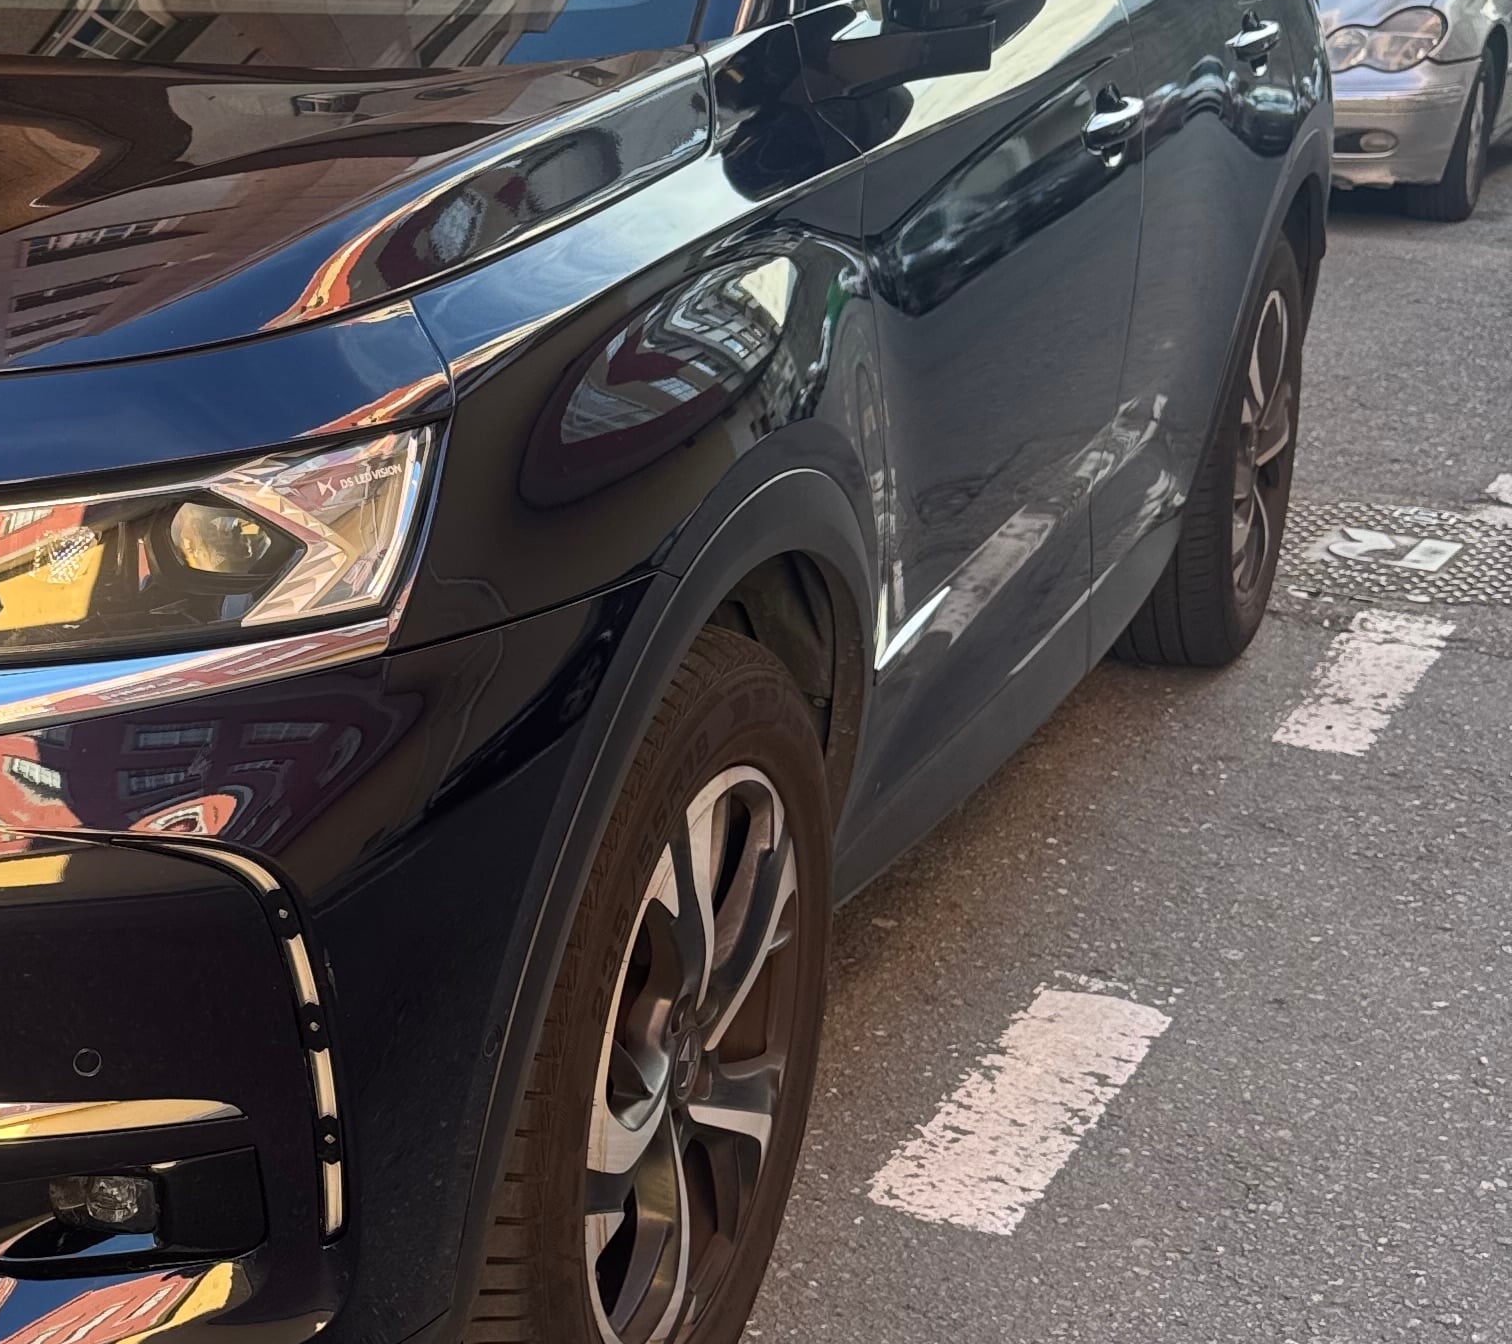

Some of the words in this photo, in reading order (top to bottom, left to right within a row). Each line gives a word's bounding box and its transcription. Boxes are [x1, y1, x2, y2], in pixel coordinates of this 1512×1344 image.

[340, 479, 354, 489] DS
[355, 472, 372, 484] LED
[373, 464, 402, 480] VISION
